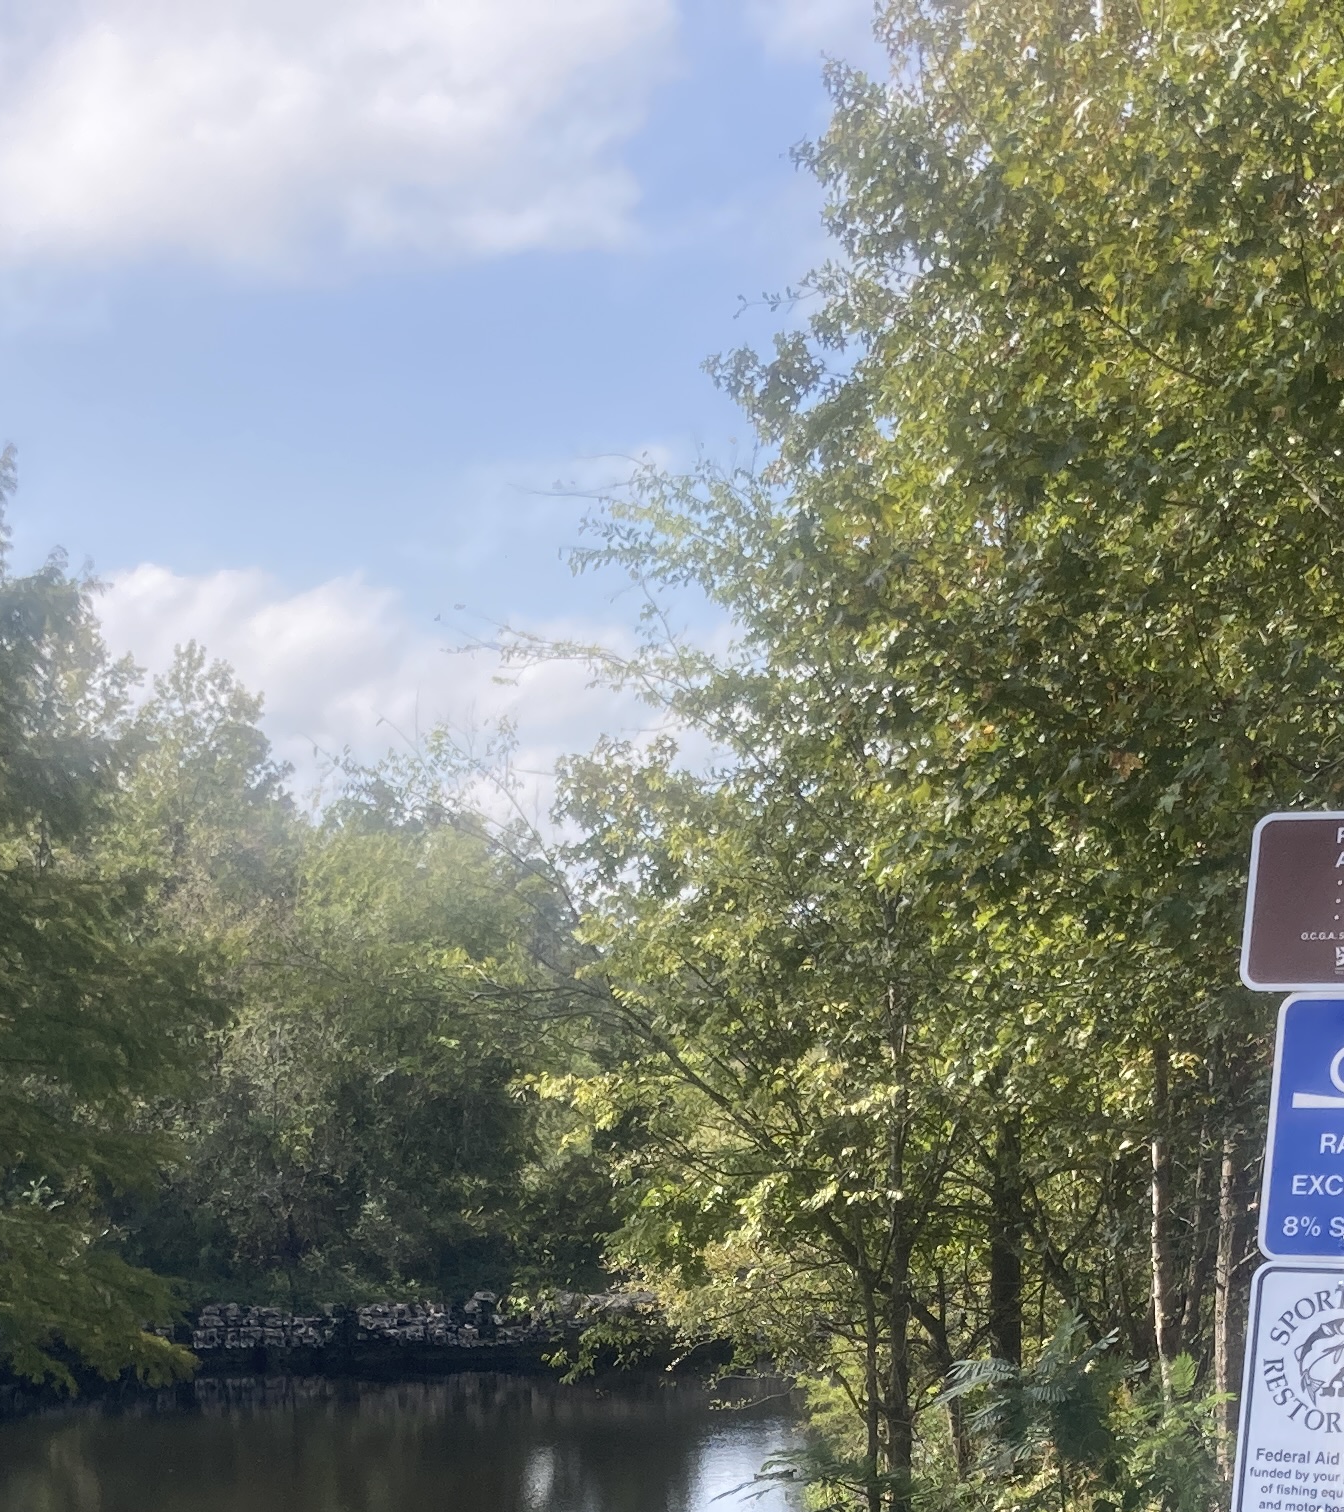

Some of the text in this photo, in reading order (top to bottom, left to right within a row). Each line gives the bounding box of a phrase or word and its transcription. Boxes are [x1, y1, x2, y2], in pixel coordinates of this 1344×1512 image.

[1282, 1216, 1322, 1238] 8%
[1256, 1447, 1311, 1464] Federal
[1315, 1451, 1340, 1466] Aid
[1249, 1466, 1292, 1480] funded
[1295, 1469, 1309, 1482] by
[1312, 1472, 1341, 1484] your
[1260, 1483, 1274, 1494] of
[1276, 1484, 1318, 1500] fishing
[1258, 1500, 1282, 1511] and
